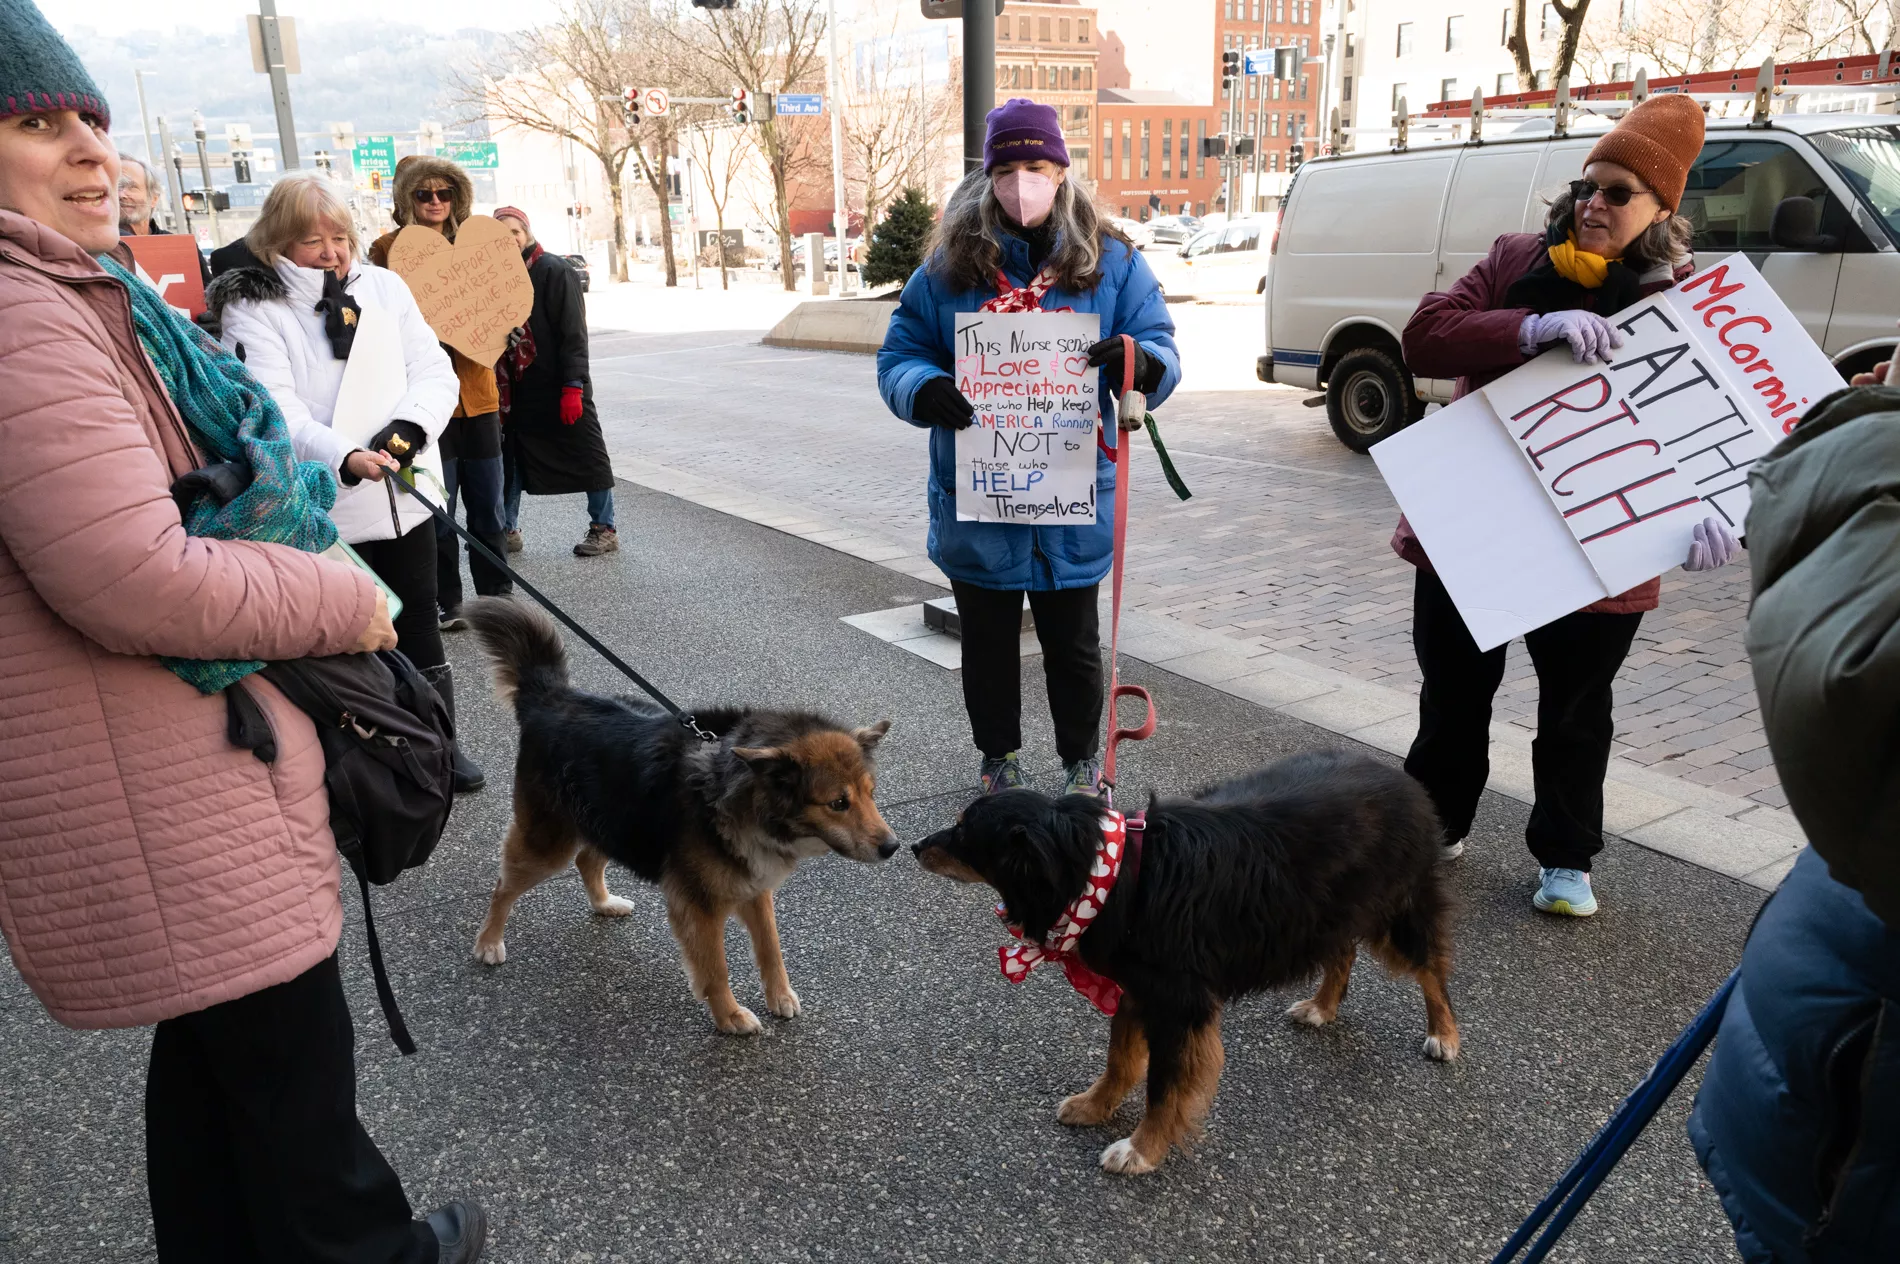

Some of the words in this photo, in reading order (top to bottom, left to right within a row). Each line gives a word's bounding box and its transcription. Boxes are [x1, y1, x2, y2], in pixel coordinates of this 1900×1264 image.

[779, 103, 801, 113] Third
[804, 103, 819, 113] Ave
[359, 149, 369, 157] Ft
[371, 149, 388, 157] Pitt
[1023, 138, 1045, 146] Woman
[360, 158, 389, 167] Bridge
[1152, 188, 1168, 196] OFFICE
[414, 282, 440, 303] OUR
[436, 243, 492, 286] SUPPORT
[494, 235, 516, 254] FOR
[422, 263, 498, 325] BILLIONAIRES
[501, 258, 514, 272] IS
[440, 285, 501, 338] BREAKING
[505, 274, 527, 294] OUR
[466, 302, 519, 350] HEARTS
[957, 320, 1001, 356] This
[1010, 330, 1052, 353] Nurse
[1604, 304, 1720, 410] EAT
[1680, 264, 1809, 437] McCormic
[980, 354, 1041, 377] Love
[959, 375, 1078, 401] Appreciation
[1082, 382, 1095, 394] to
[972, 402, 993, 412] ose
[996, 399, 1023, 411] who
[1027, 396, 1055, 414] Help
[971, 413, 1044, 430] AMERICA
[1052, 412, 1094, 435] Running
[993, 430, 1059, 458] NOT
[1063, 439, 1081, 451] to
[971, 457, 1011, 471] those
[1018, 458, 1049, 470] who
[1510, 372, 1702, 545] RICH
[972, 470, 1044, 492] HELP
[985, 484, 1096, 520] Themselves!
